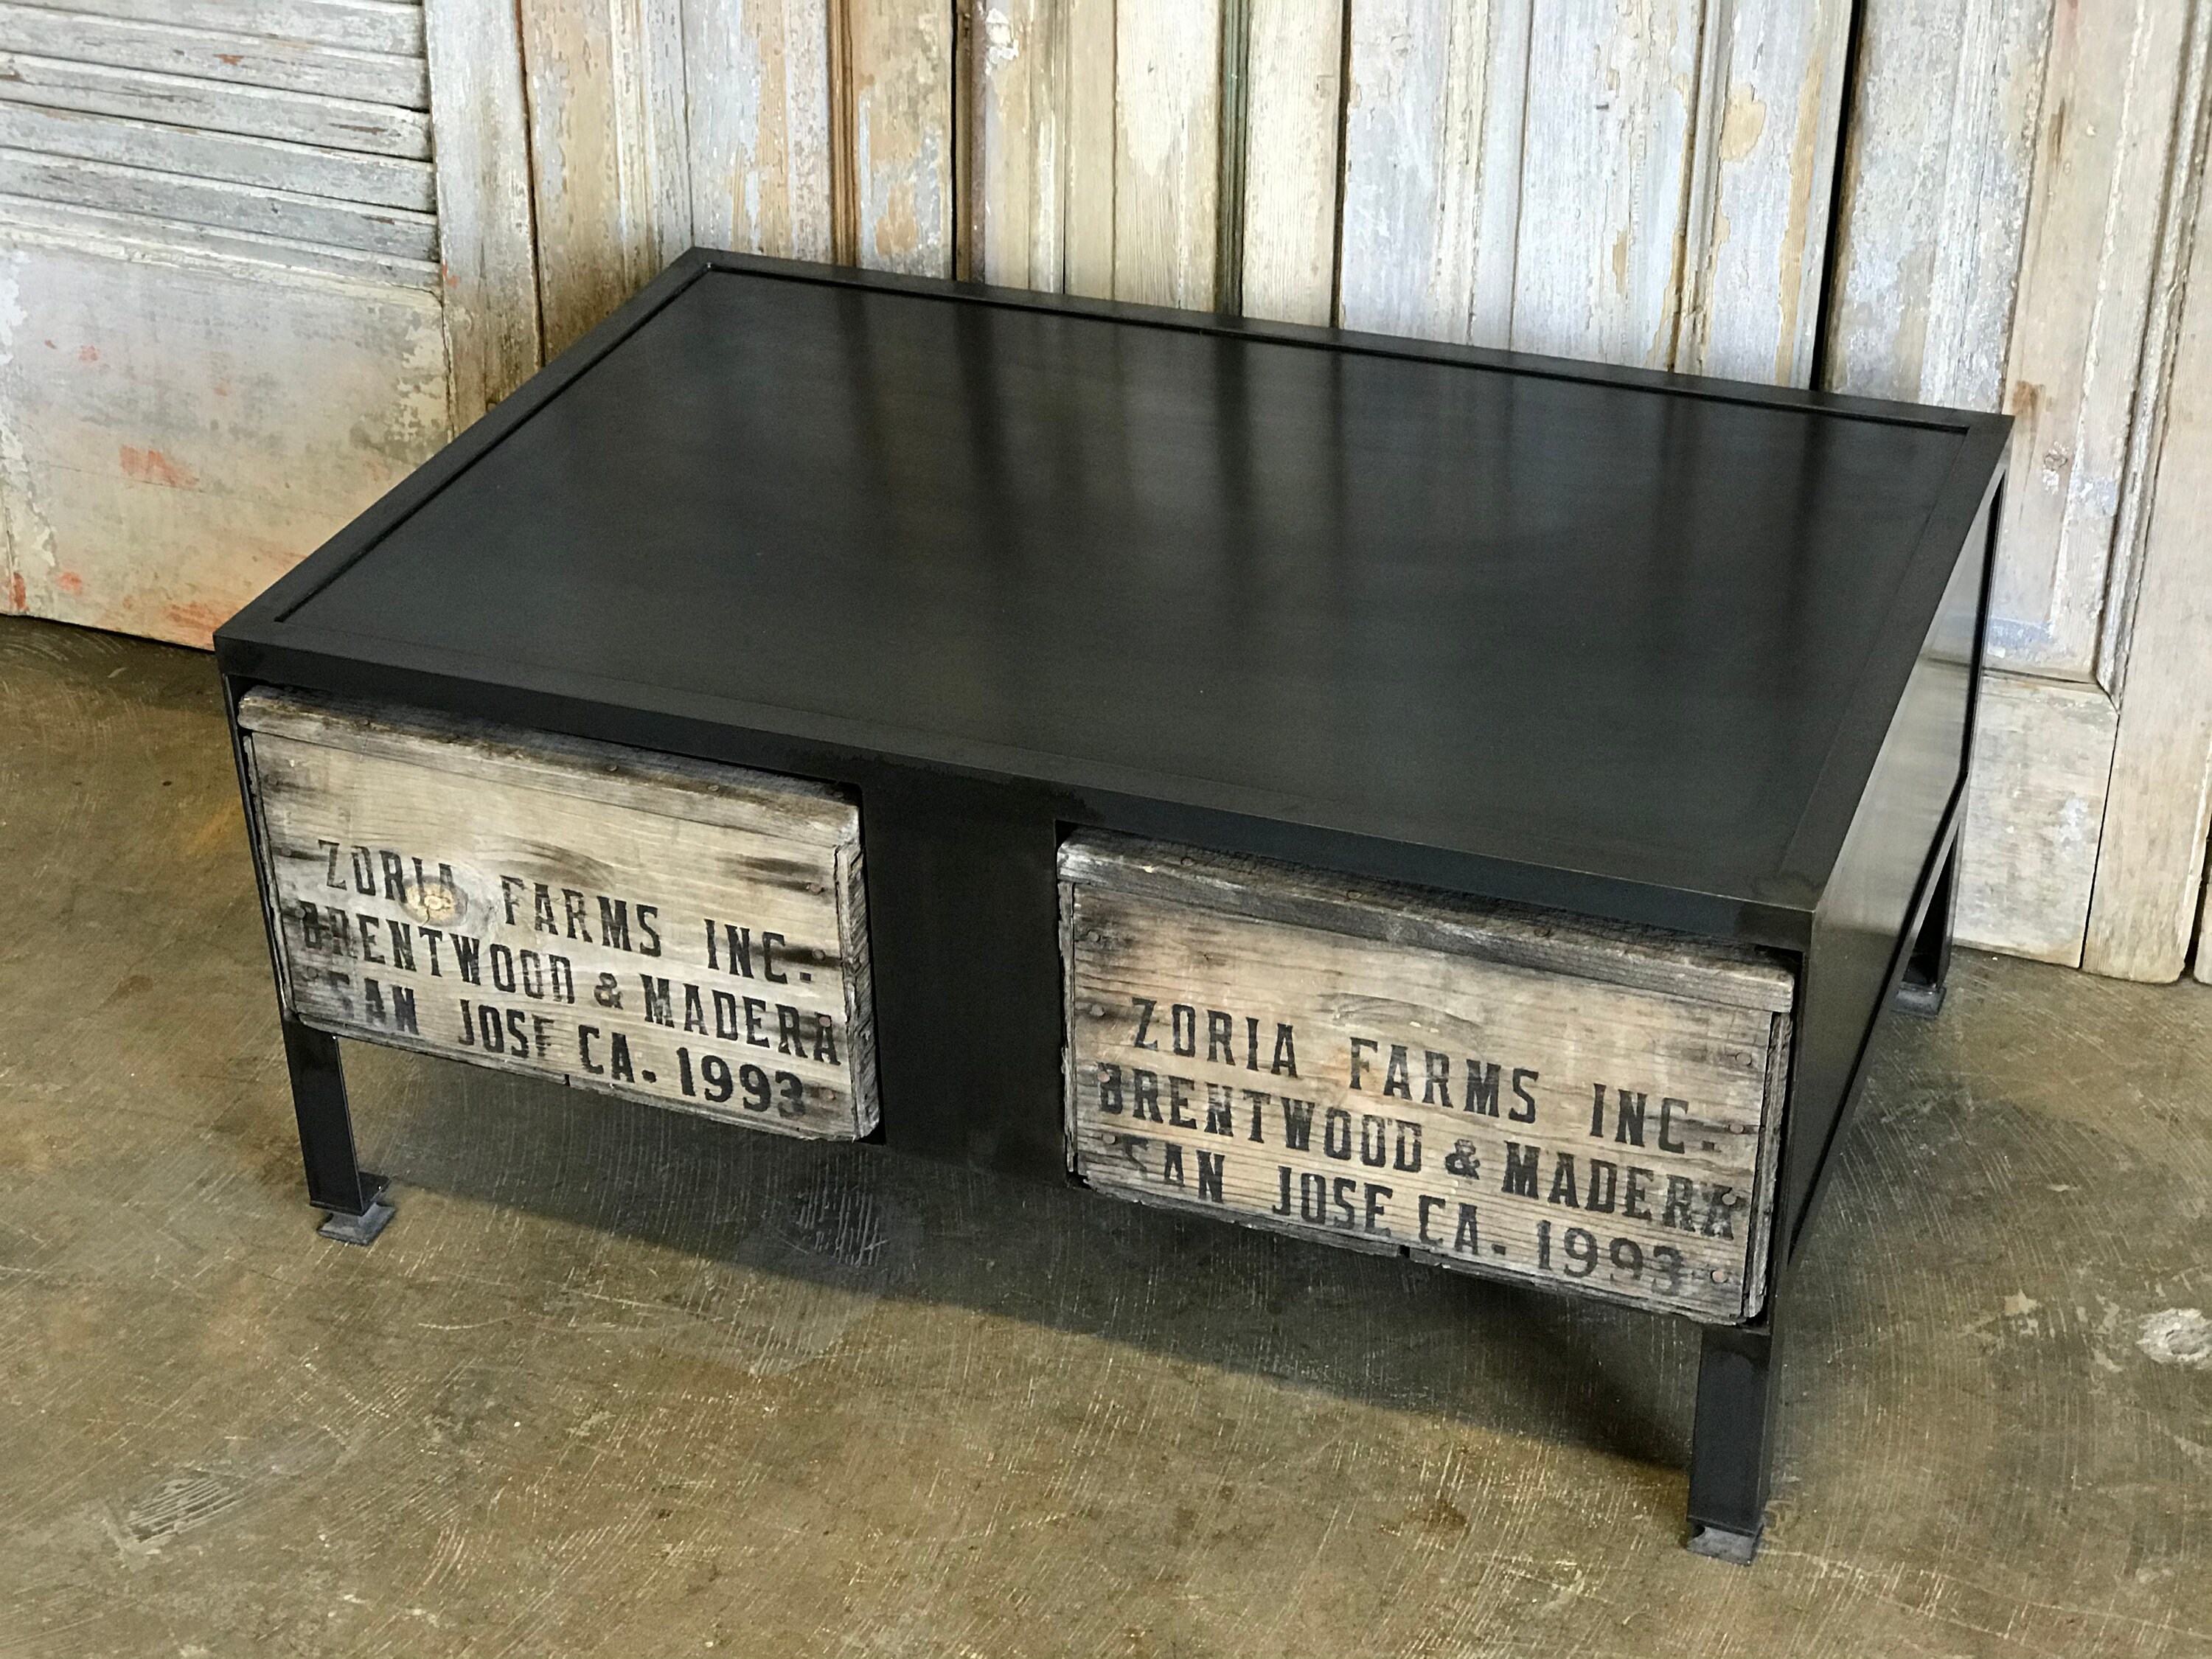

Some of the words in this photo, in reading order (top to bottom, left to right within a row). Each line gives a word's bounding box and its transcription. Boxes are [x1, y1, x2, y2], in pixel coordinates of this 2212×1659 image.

[299, 901, 576, 1005] BRENTWOOD
[594, 973, 623, 1009] &
[640, 974, 841, 1066] MADERA
[500, 875, 662, 957] FARMS
[705, 919, 812, 984] INC.
[458, 999, 554, 1059] JOSE
[579, 1025, 657, 1084] CA.
[677, 1047, 807, 1119] 1993
[1133, 998, 1297, 1078] ZORIA
[1349, 1037, 1539, 1124] FARMS
[1590, 1083, 1717, 1155] INC.
[1098, 1062, 1422, 1173] BRENTWOOD
[1445, 1139, 1480, 1180] &
[1502, 1141, 1736, 1240] MADERA
[1272, 1166, 1394, 1237] JOSE
[1418, 1195, 1506, 1254] CA.
[1537, 1220, 1684, 1295] 1993
